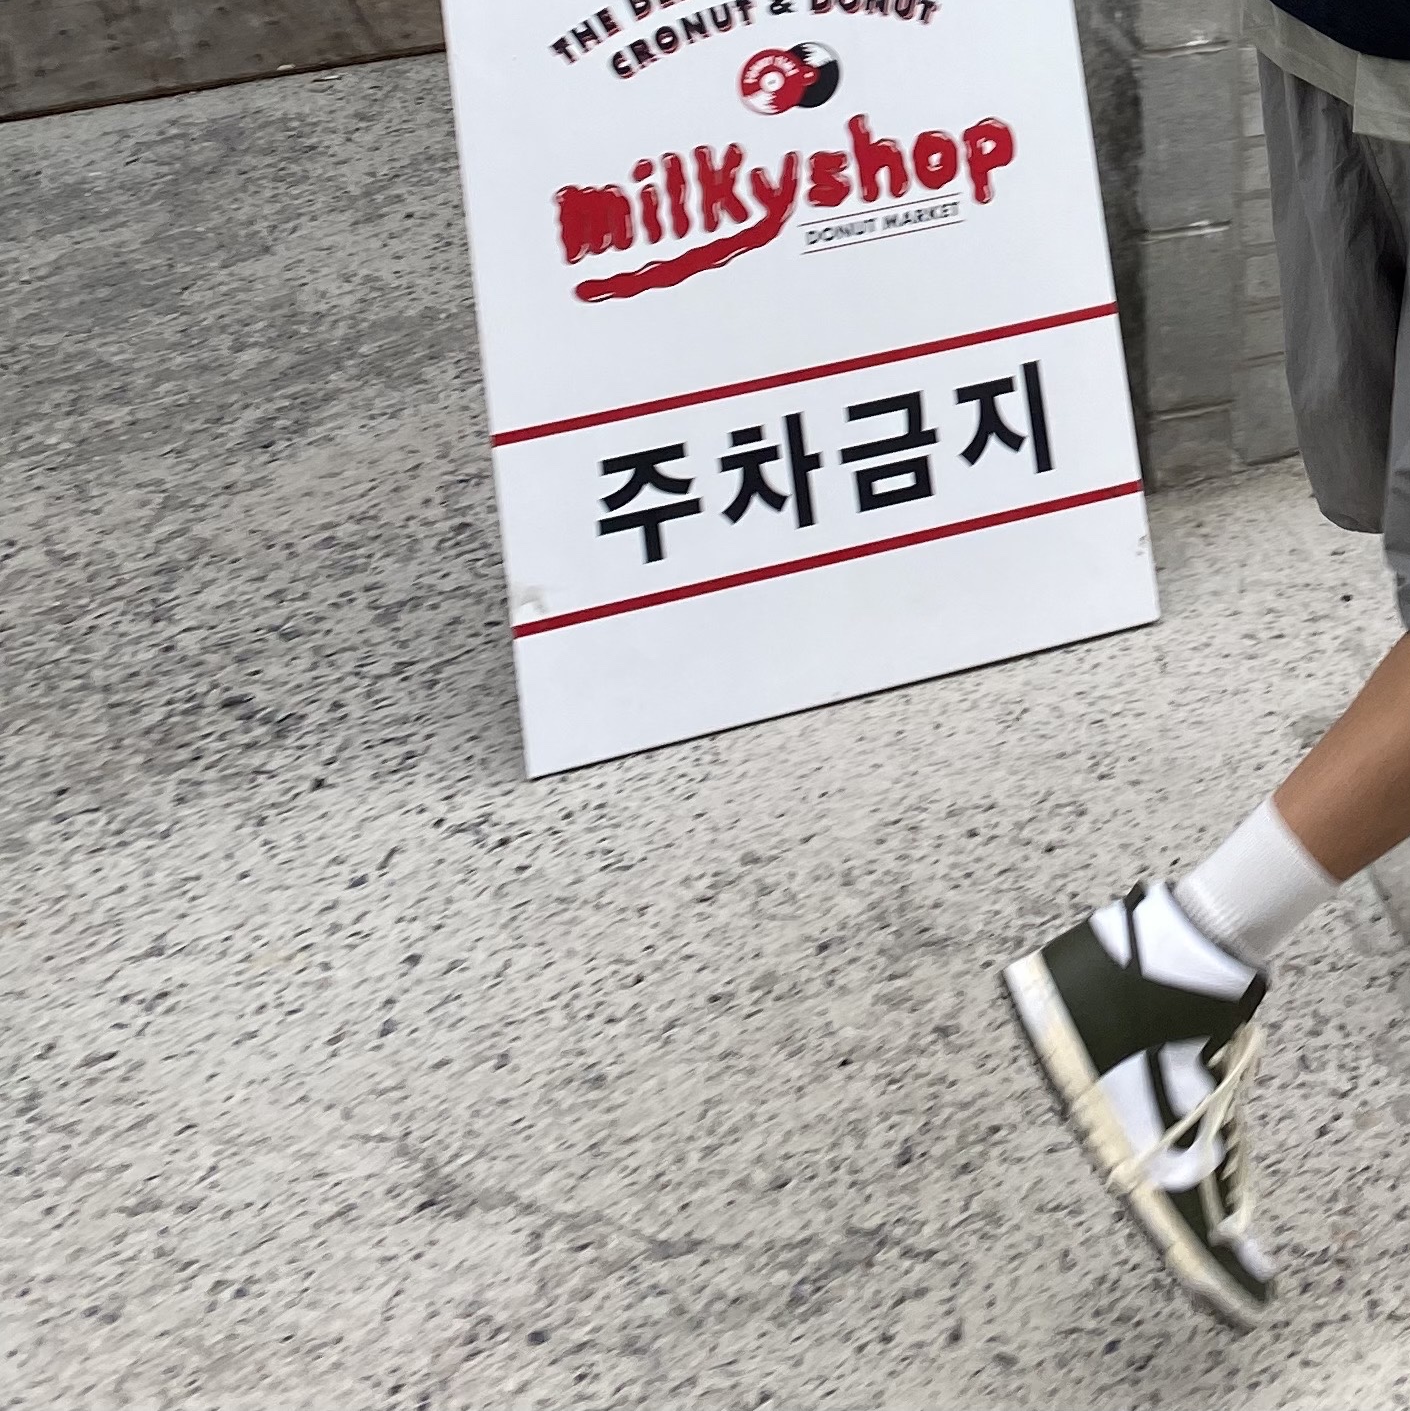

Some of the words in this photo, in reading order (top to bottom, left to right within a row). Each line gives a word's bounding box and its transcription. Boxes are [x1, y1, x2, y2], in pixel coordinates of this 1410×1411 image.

[549, 8, 622, 65] THE
[805, 218, 877, 246] DONUT
[881, 202, 962, 231] MARKET
[596, 359, 1055, 564] 주차금지
